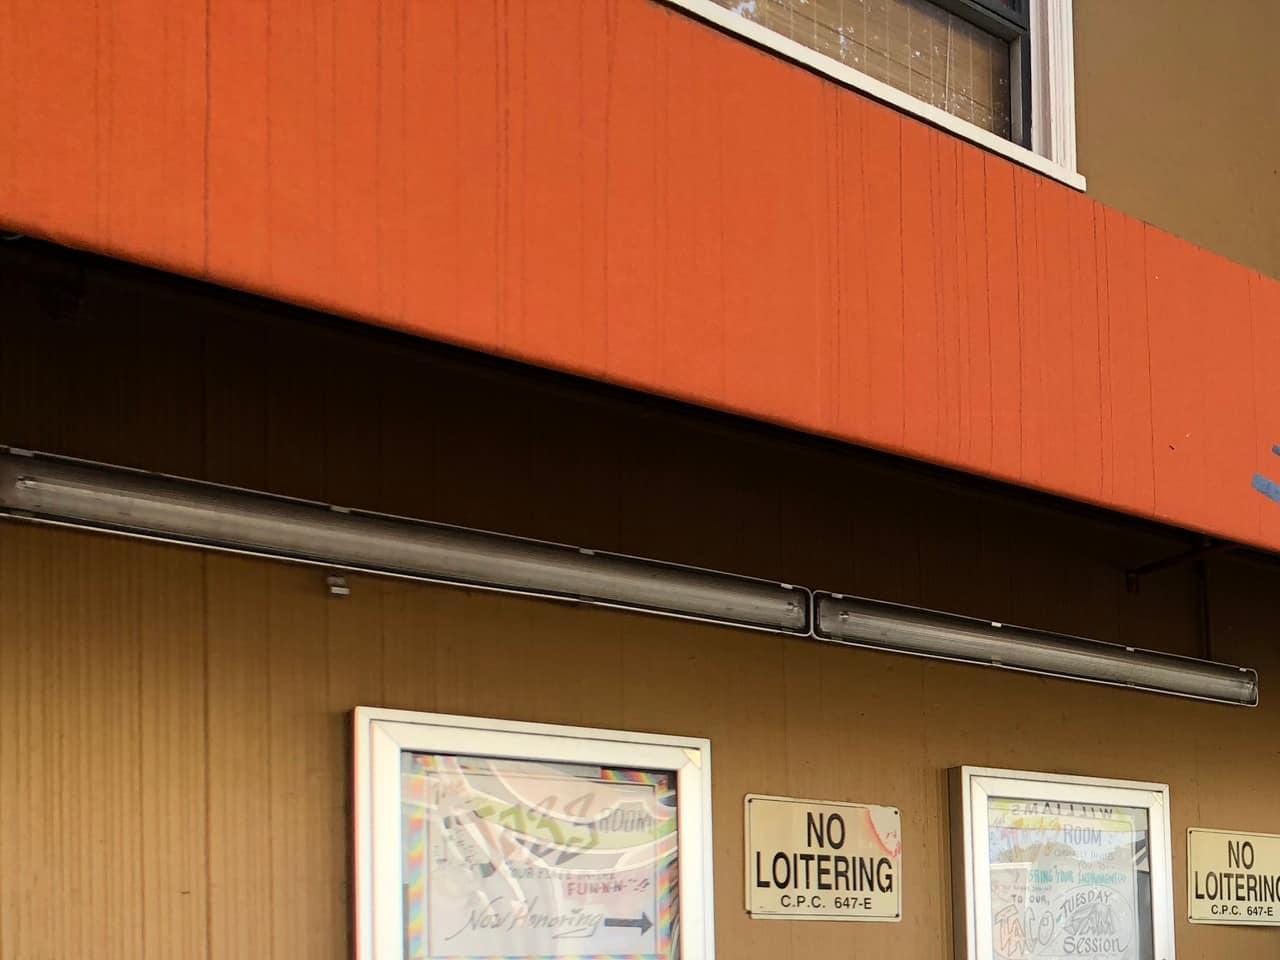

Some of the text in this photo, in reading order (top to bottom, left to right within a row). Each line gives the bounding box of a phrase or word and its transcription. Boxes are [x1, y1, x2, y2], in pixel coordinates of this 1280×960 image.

[806, 812, 846, 850] NO
[1228, 839, 1255, 870] NO
[756, 851, 893, 894] LOITERING
[780, 894, 873, 910] C.P.C. 647-E
[1060, 889, 1113, 918] TUESDAY
[1211, 904, 1274, 917] C.P.C. 647-E
